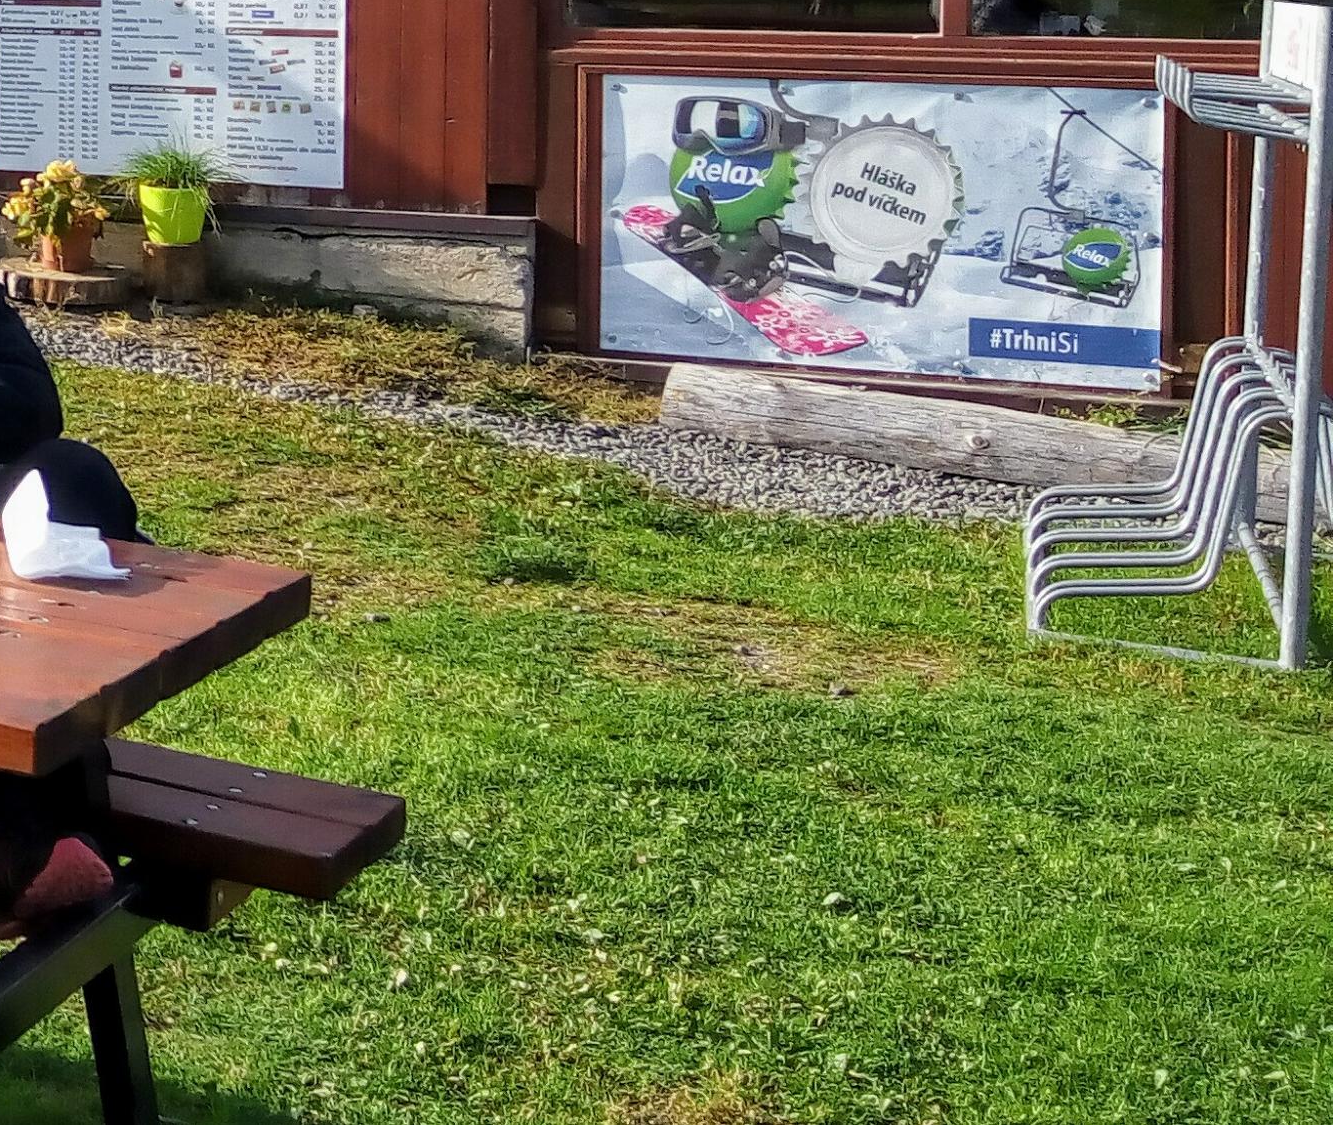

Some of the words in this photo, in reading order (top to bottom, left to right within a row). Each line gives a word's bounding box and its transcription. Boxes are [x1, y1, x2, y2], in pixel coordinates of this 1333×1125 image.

[687, 157, 766, 188] Relax
[860, 162, 917, 196] Hláška
[832, 181, 867, 203] pod
[868, 193, 928, 225] víčkem
[1073, 244, 1112, 268] Relax
[989, 328, 1080, 355] #TrhniSi
